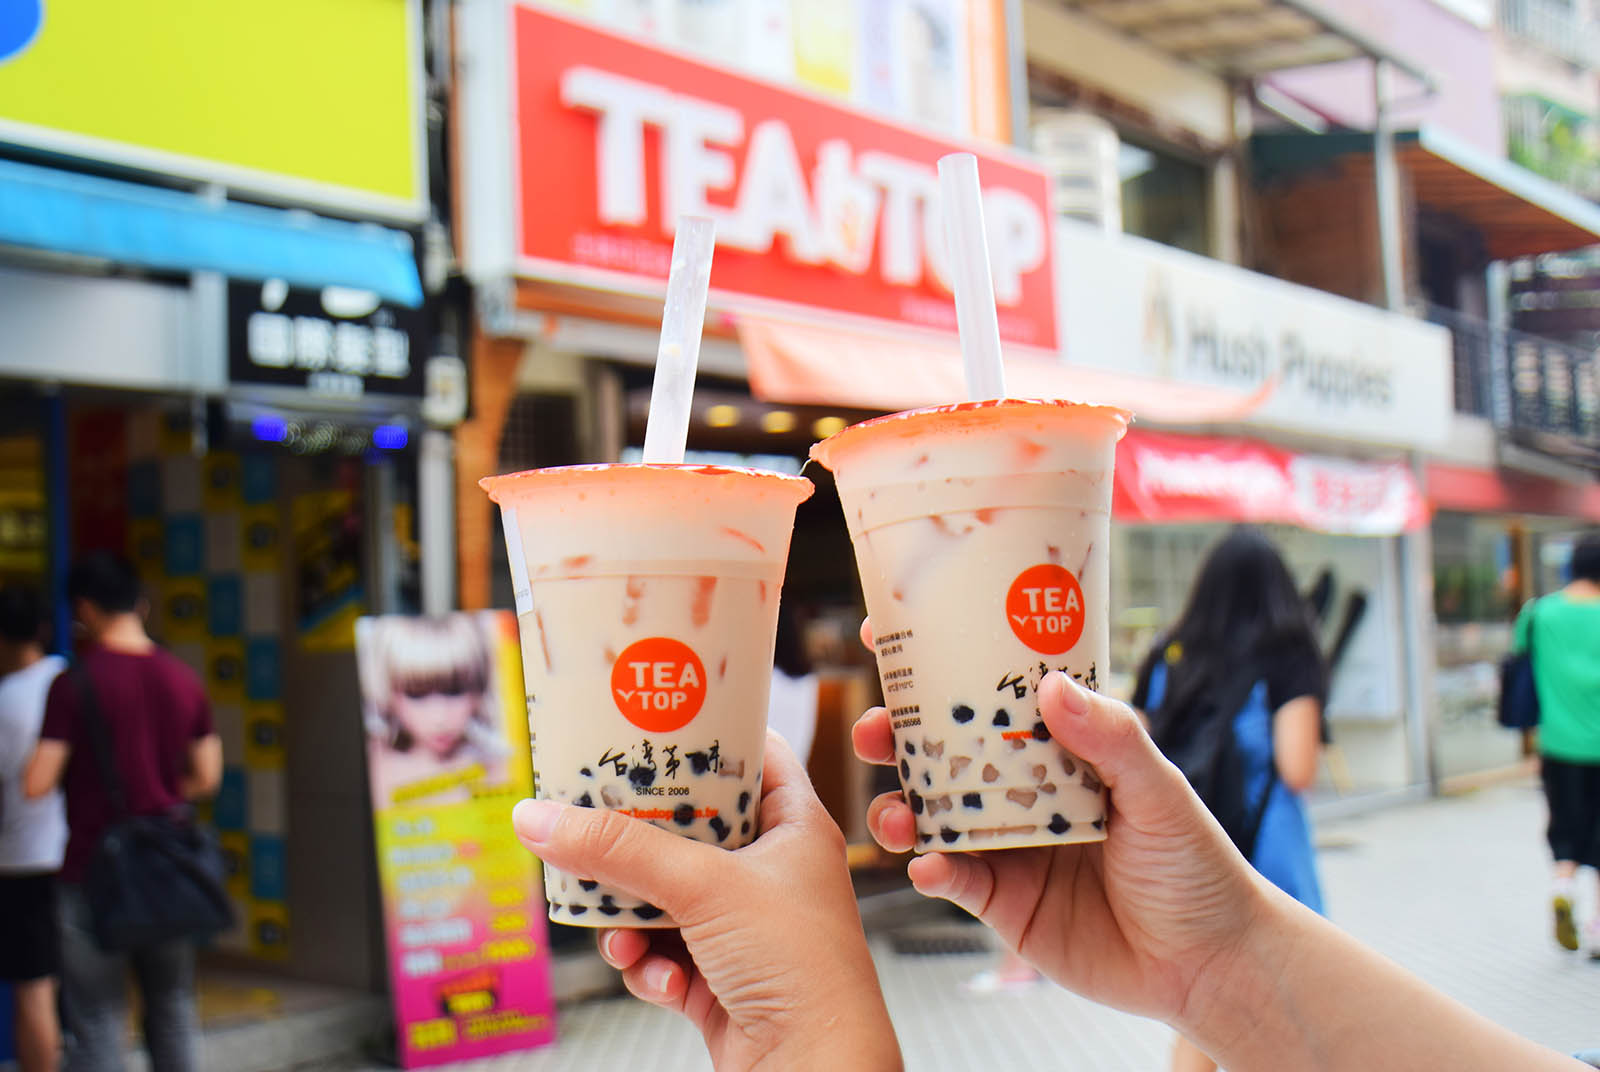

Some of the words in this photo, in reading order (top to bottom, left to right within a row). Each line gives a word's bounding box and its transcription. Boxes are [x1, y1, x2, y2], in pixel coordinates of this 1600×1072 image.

[560, 66, 826, 268] TEA
[1021, 587, 1080, 613] TEA
[628, 661, 699, 689] TEA
[636, 786, 665, 796] SINCE
